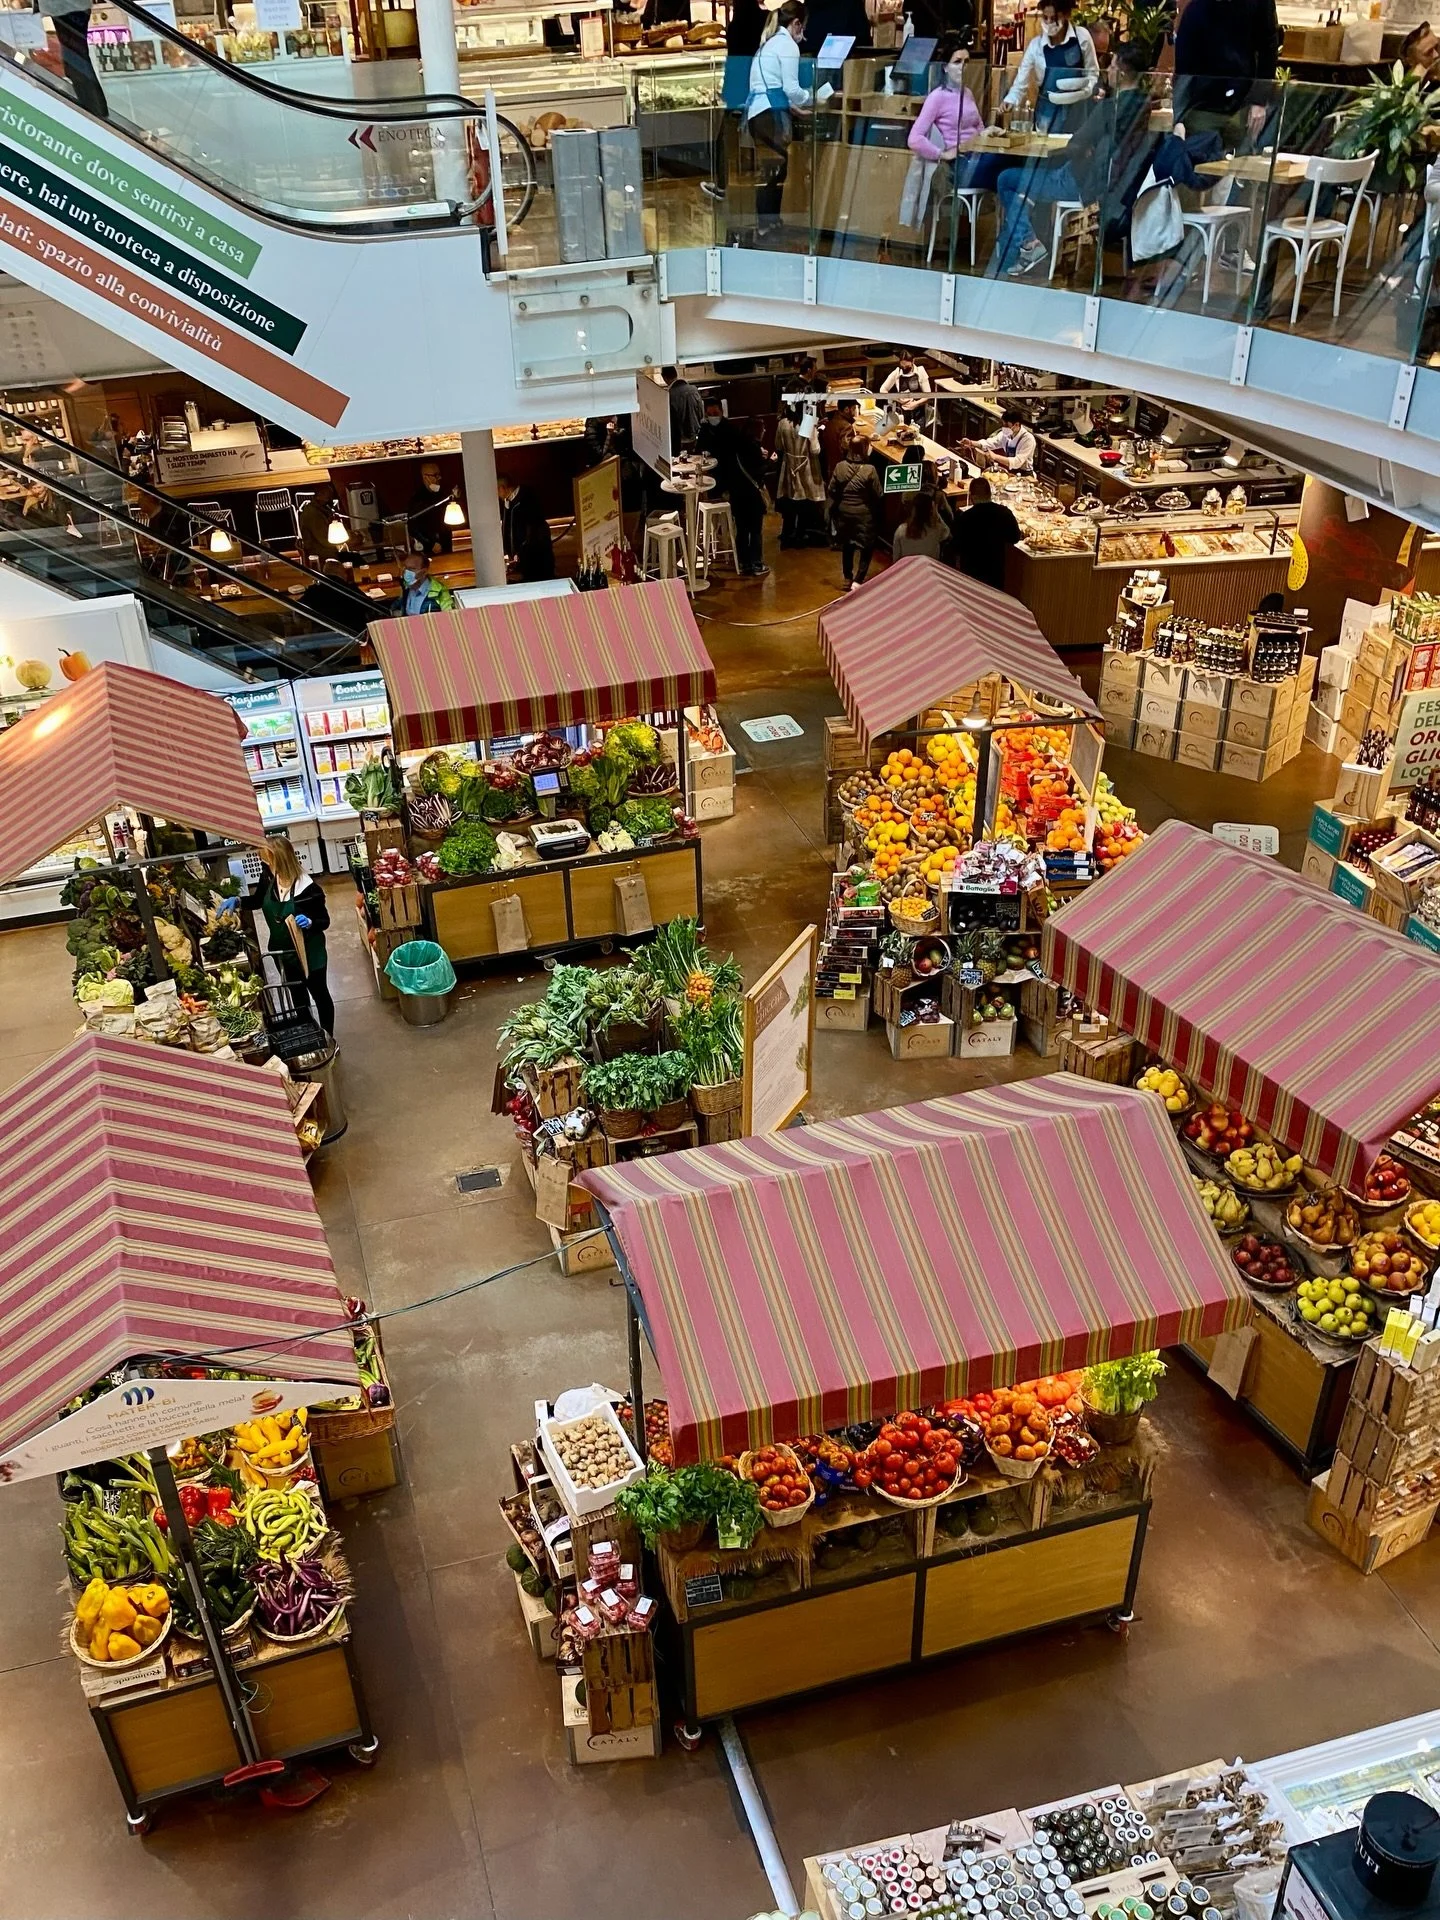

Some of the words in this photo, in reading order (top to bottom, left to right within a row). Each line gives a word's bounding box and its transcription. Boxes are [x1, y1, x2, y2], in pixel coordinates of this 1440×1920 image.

[86, 160, 129, 192] dove
[131, 188, 194, 232] sentirsi
[195, 226, 206, 240] a
[208, 235, 244, 264] casa
[0, 162, 33, 195] ere,
[38, 183, 68, 210] hai
[163, 260, 174, 274] a
[177, 268, 275, 332] disposizione
[36, 239, 93, 278] spazio
[95, 273, 126, 297] alla
[128, 292, 222, 352] convivialità
[173, 454, 198, 462] NOSTRO
[336, 682, 372, 695] Bontà
[971, 1036, 1001, 1044] EATALY
[86, 1424, 113, 1435] Cosa
[114, 1415, 147, 1429] hanno
[149, 1410, 159, 1419] in
[161, 1400, 202, 1415] comune
[91, 1424, 138, 1441] sacchetti
[159, 1411, 192, 1426] buccia
[193, 1401, 216, 1414] della
[218, 1394, 246, 1408] mela?
[107, 1397, 176, 1420] MATER-BI
[592, 1735, 640, 1747] EATALY
